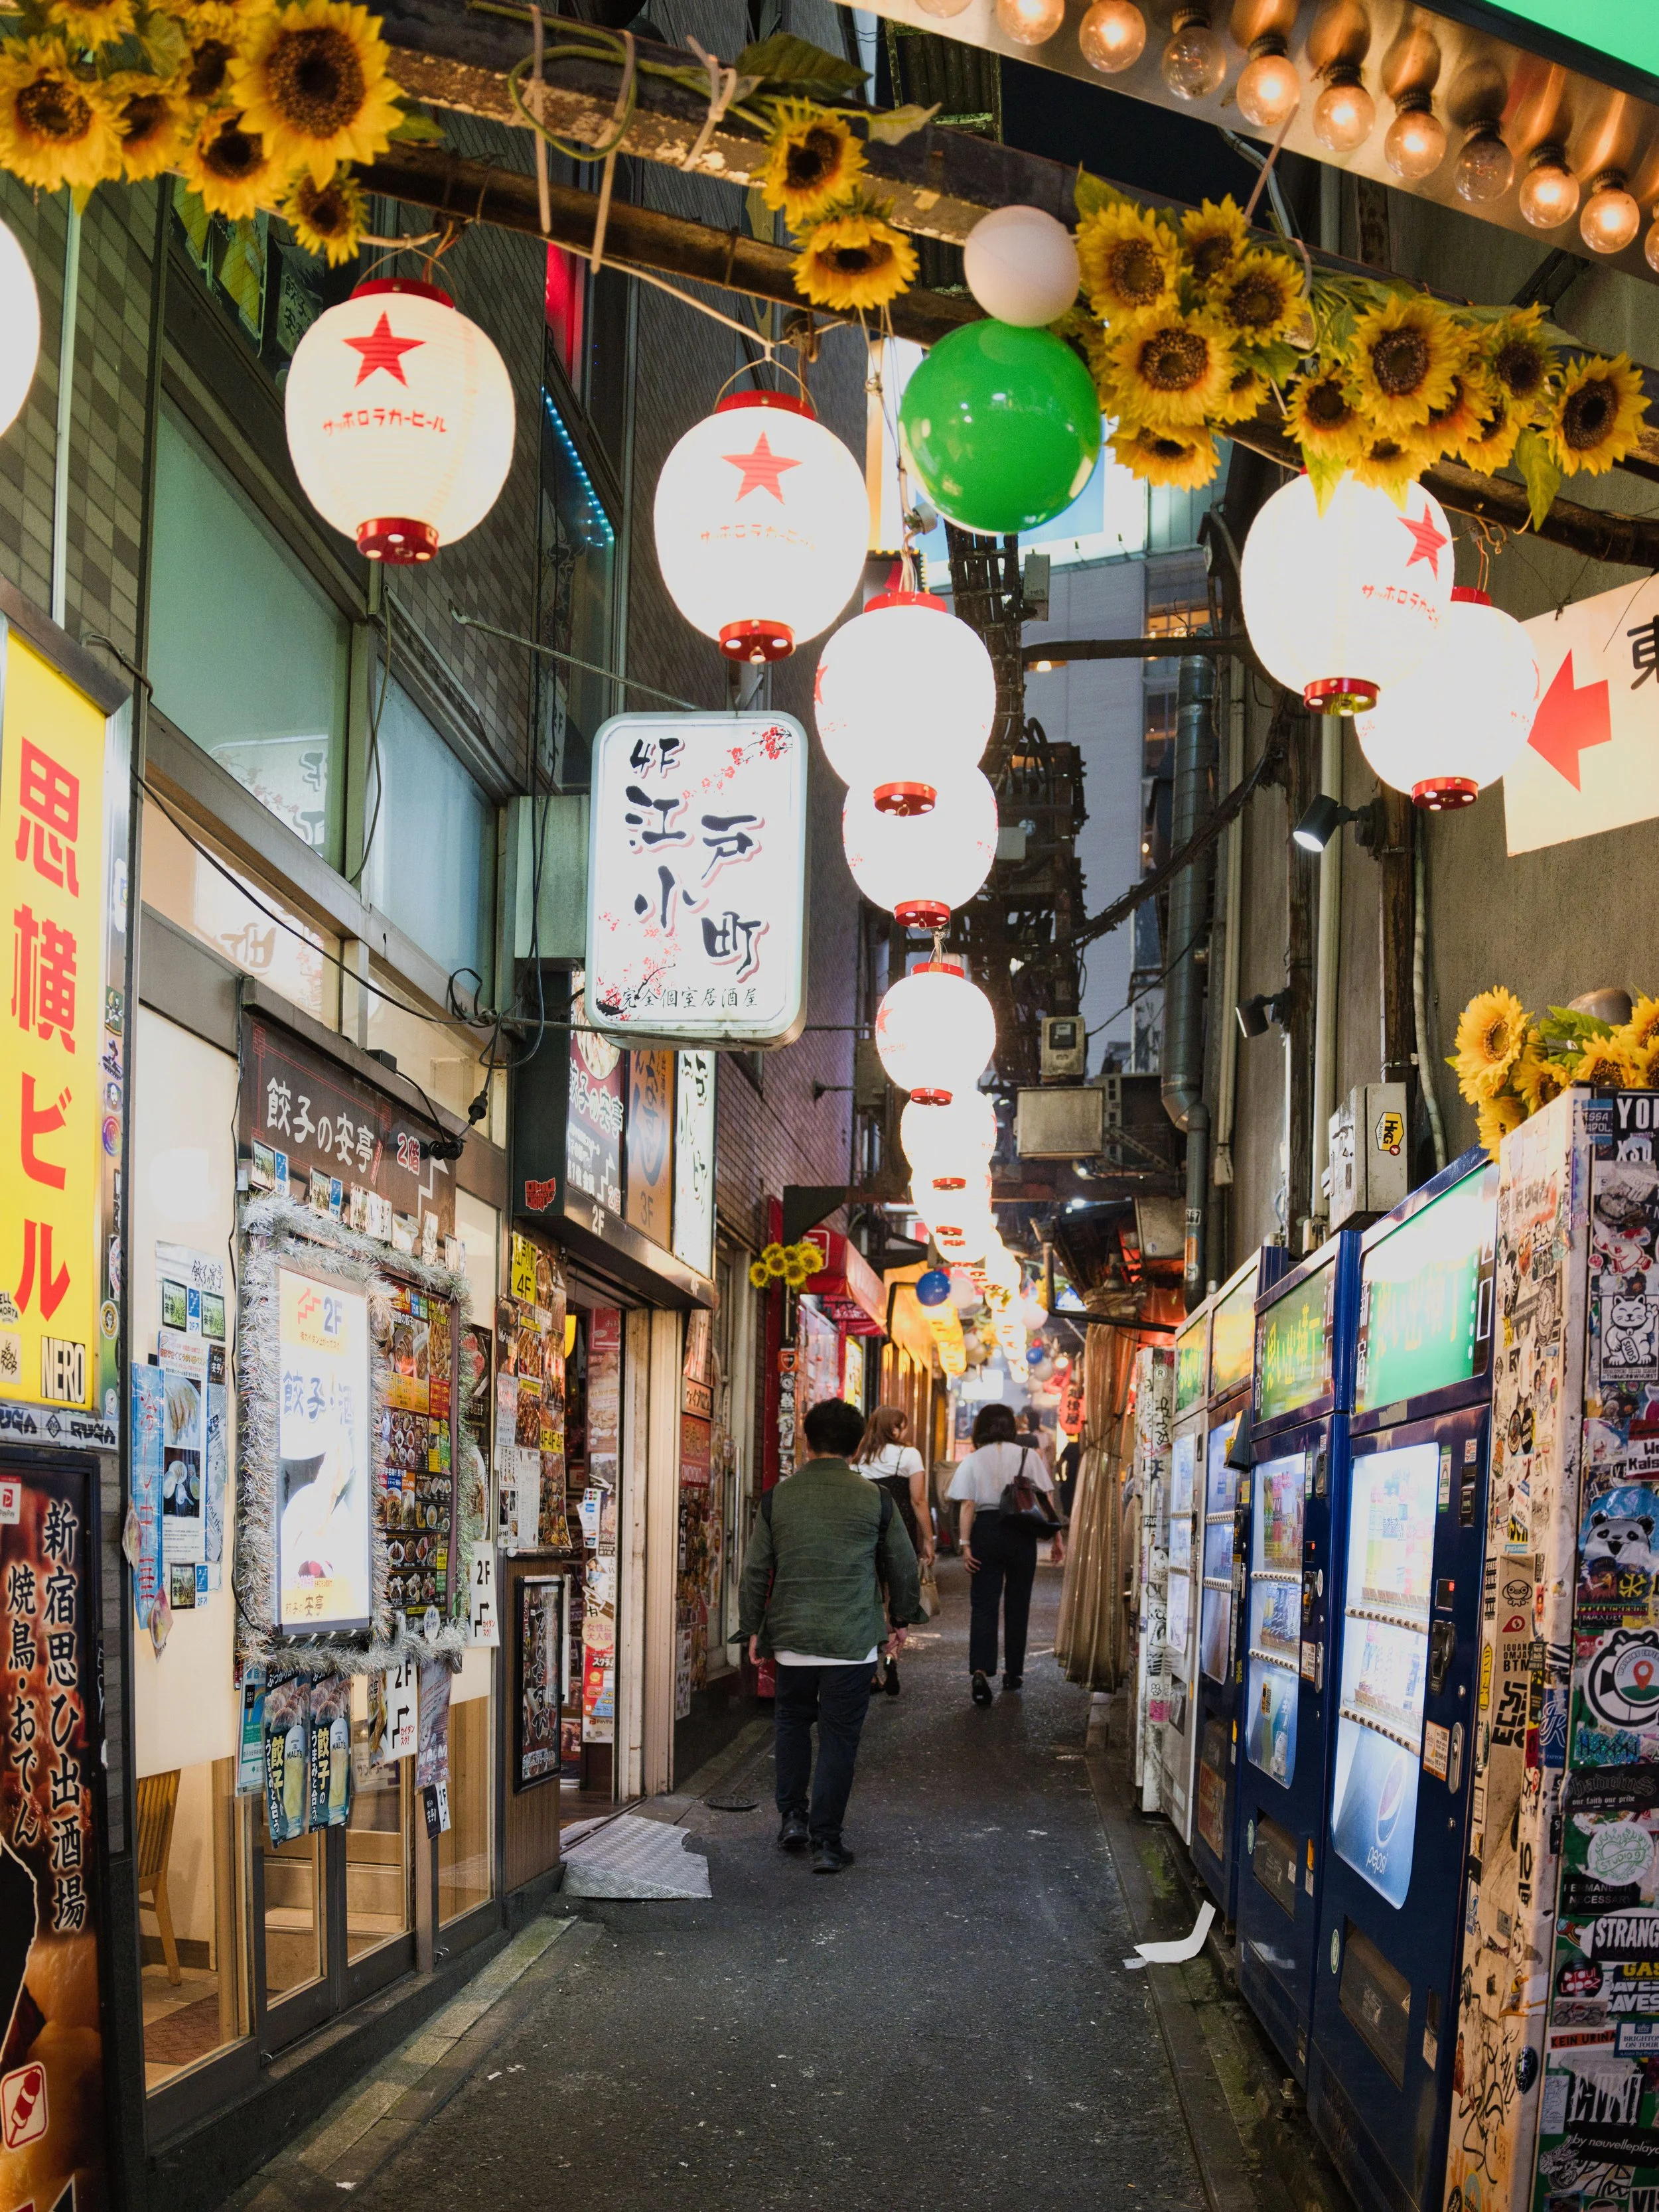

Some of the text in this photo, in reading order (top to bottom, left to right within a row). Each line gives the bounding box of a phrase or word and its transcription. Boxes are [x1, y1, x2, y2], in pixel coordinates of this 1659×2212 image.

[622, 987, 759, 1008] 完全個室居酒屋
[11, 736, 79, 1322] 思横ビル
[266, 1077, 374, 1173] 餃子の安亭
[1382, 1119, 1398, 1144] HKG
[396, 1132, 421, 1177] 2階
[592, 1204, 605, 1235] 2F
[640, 1190, 654, 1228] 3F
[517, 1273, 532, 1298] 4F
[323, 1296, 343, 1336] 2F
[1623, 1340, 1637, 1361] SUDS
[41, 1336, 86, 1404] NERO
[549, 1432, 556, 1450] 4F
[476, 1559, 490, 1585] 2F
[482, 1619, 495, 1630] カイダン
[587, 1623, 612, 1633] 女性に
[587, 1632, 613, 1642] 大人気
[5, 1563, 40, 1847] 焼鳥・おでん
[43, 1501, 86, 1932] 新宿思ひ出酒場
[401, 1724, 415, 1736] カイダン
[401, 1734, 410, 1746] スグ!
[287, 1748, 303, 1759] MALT'S
[332, 1740, 346, 1750] MALT'S
[317, 1727, 330, 1805] 餃子の
[1586, 1795, 1603, 1805] faith
[1619, 1794, 1636, 1804] pride
[1366, 1846, 1388, 1874] pepsi
[1601, 1852, 1634, 1870] STUDIO
[1551, 2035, 1578, 2047] KEIN
[1572, 2133, 1587, 2147] by
